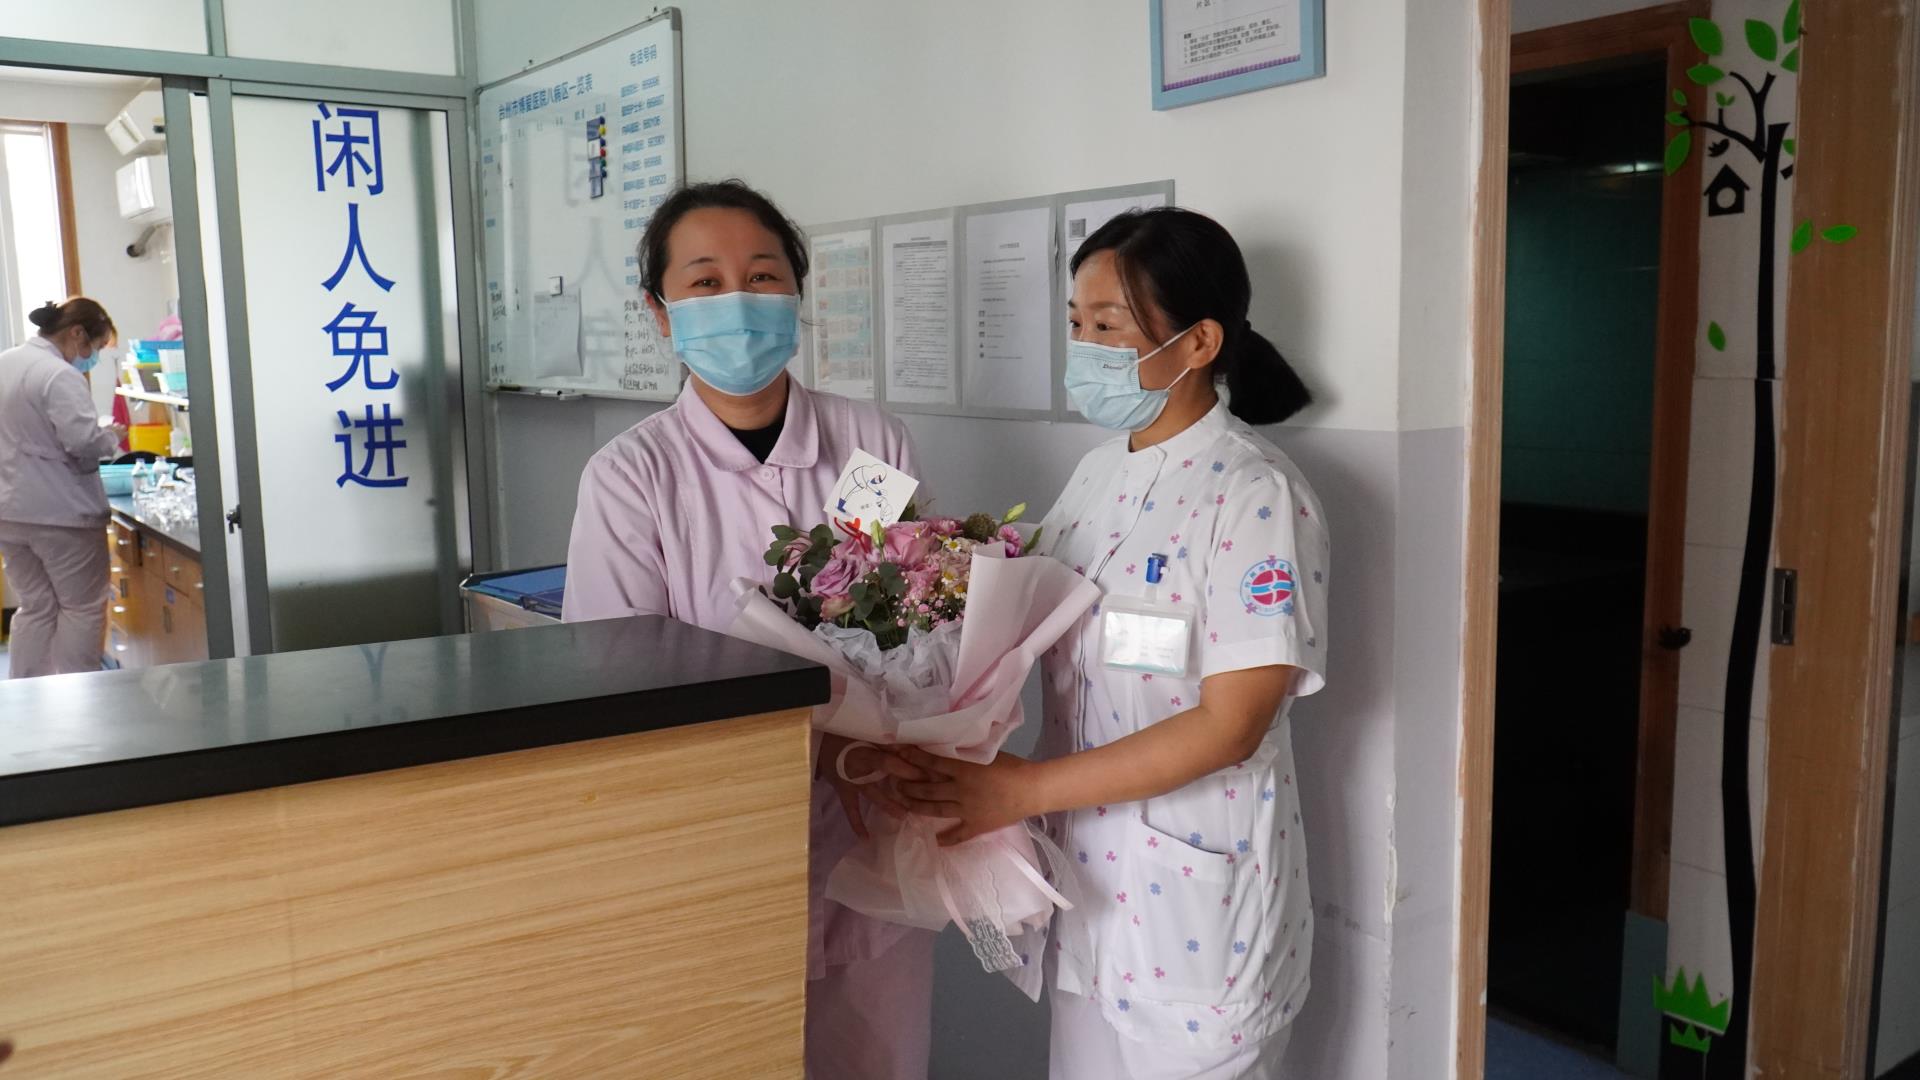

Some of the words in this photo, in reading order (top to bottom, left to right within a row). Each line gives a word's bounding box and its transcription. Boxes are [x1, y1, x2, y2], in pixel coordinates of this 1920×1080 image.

[630, 44, 657, 66] 电话号码
[312, 102, 409, 488] 闲人免进
